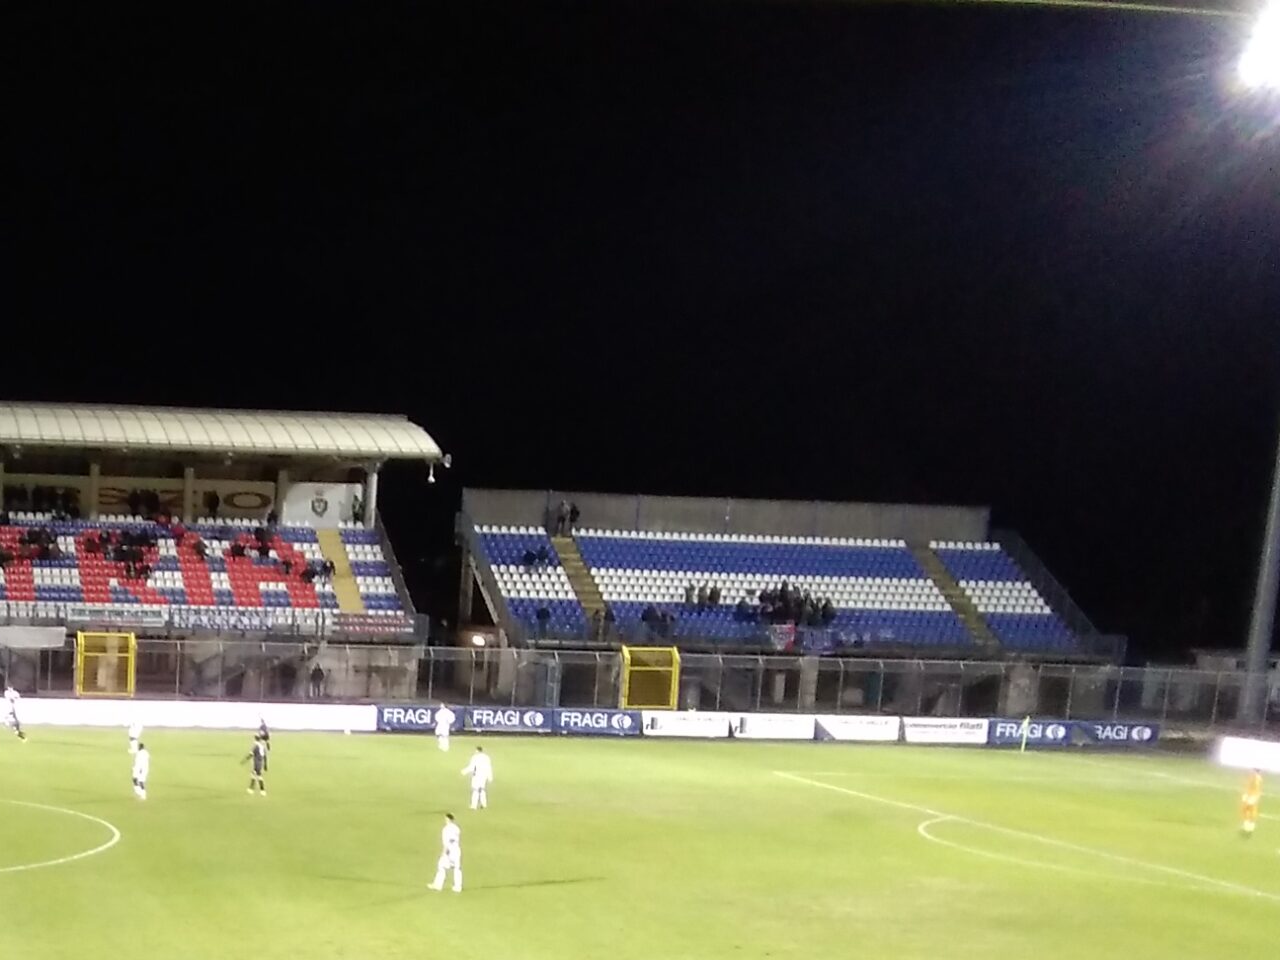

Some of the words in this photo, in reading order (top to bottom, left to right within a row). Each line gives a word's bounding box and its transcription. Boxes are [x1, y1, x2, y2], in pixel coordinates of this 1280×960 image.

[383, 708, 431, 724] FRAGI
[472, 710, 520, 726] FRAGI
[560, 712, 607, 728] FRAGI
[996, 722, 1042, 739] FRAGI
[1094, 724, 1128, 740] RAGI
